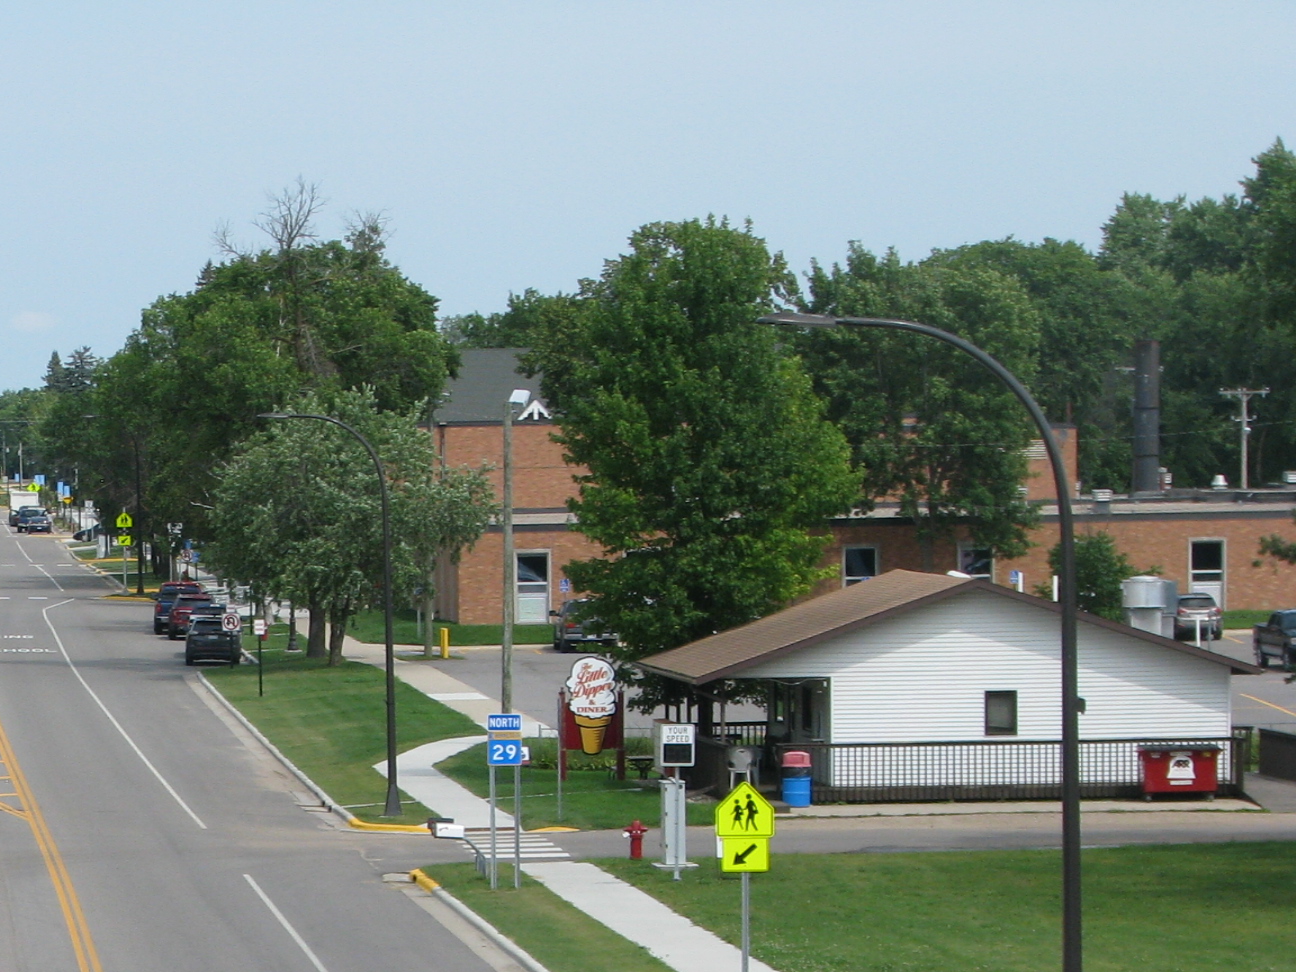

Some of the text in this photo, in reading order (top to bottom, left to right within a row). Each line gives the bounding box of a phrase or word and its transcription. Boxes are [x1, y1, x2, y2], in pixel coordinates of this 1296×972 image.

[576, 666, 609, 683] Little
[572, 681, 614, 700] Dipper
[489, 717, 520, 728] NORTH
[668, 726, 688, 734] YOUR
[492, 744, 517, 761] 29
